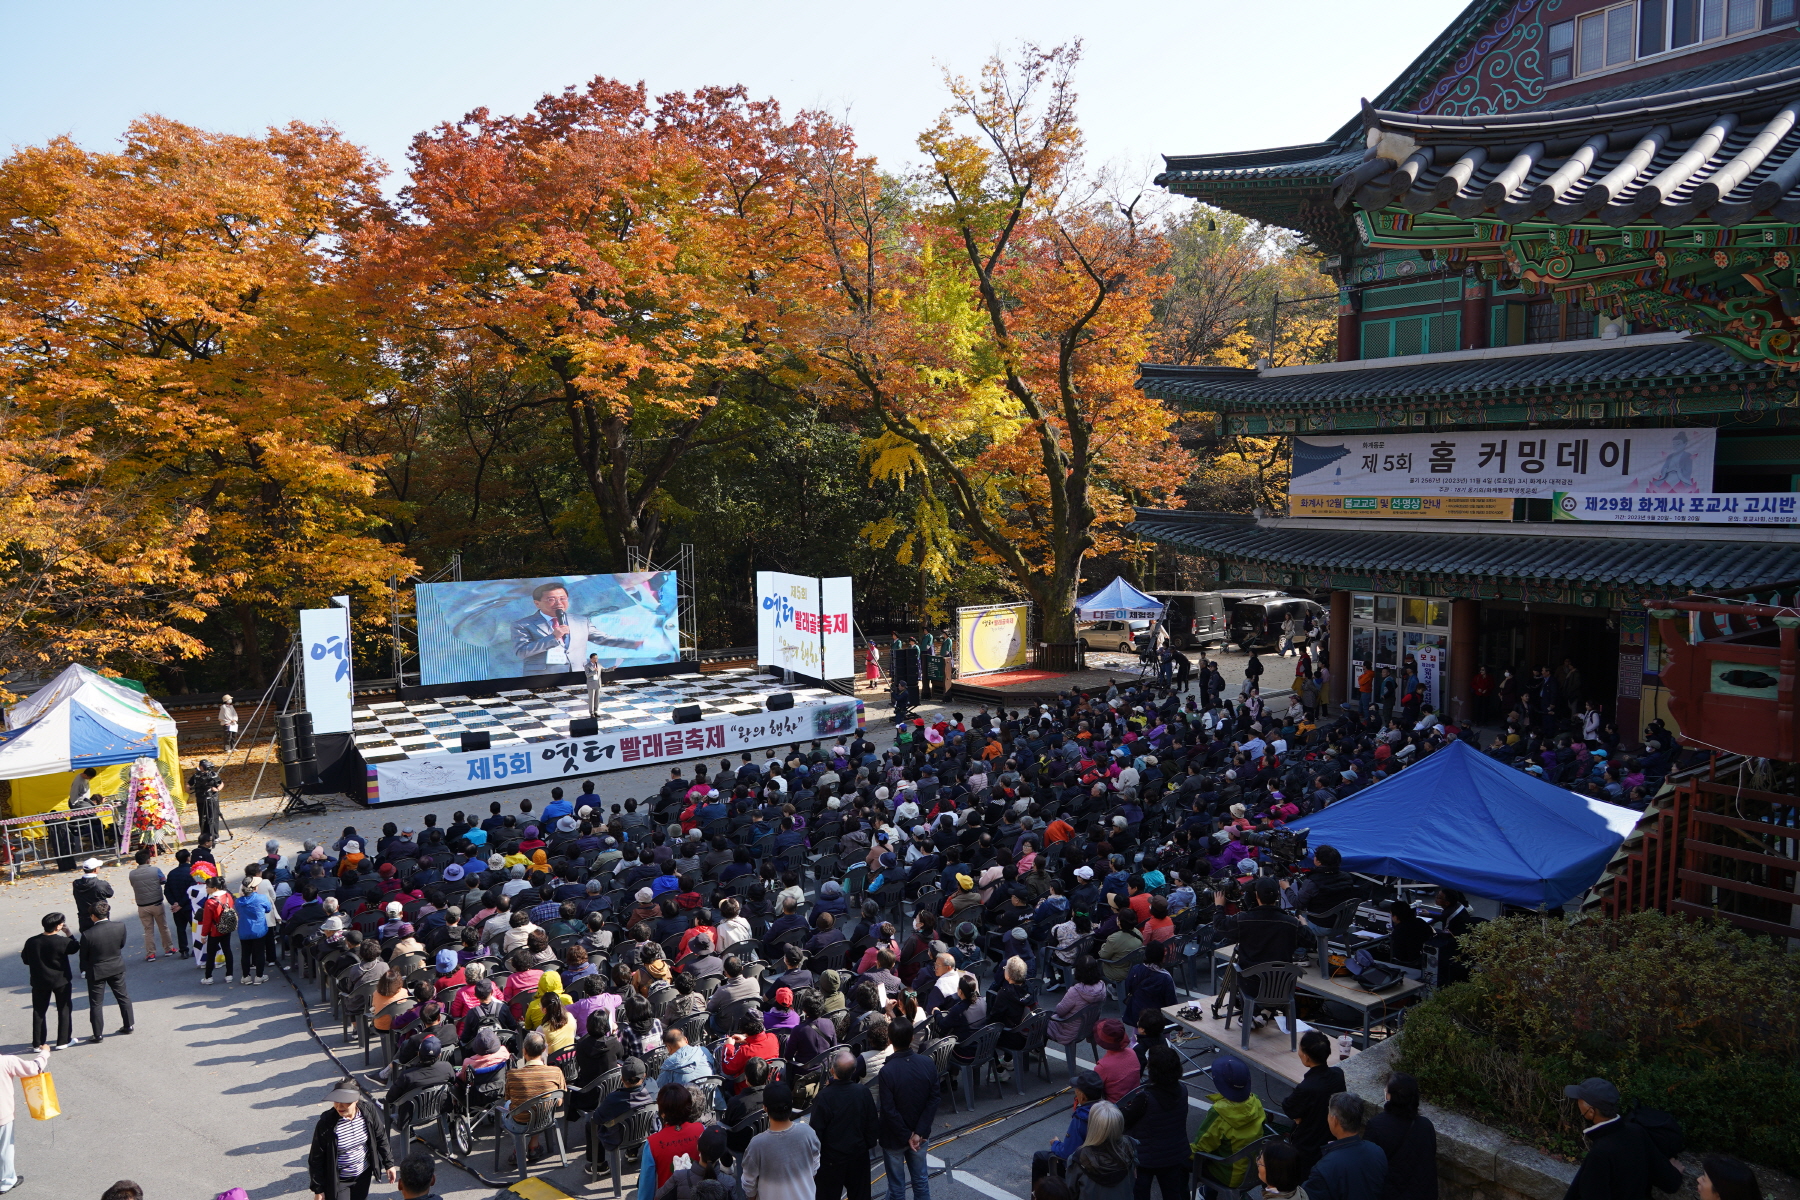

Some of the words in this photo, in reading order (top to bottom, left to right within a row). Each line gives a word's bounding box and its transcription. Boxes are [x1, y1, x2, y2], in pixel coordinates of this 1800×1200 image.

[1482, 477, 1492, 485] 4일
[1493, 477, 1516, 485] (토요일)
[1300, 498, 1324, 509] 화계사
[1326, 498, 1342, 509] 12월
[1344, 498, 1378, 509] 불교교리
[1380, 498, 1389, 509] 및
[1422, 498, 1441, 509] 안내
[1584, 496, 1633, 512] 제29회
[1638, 496, 1686, 513] 화계사
[1689, 497, 1739, 513] 포교사
[1744, 496, 1797, 514] 고시반
[790, 585, 808, 600] 제5회
[762, 592, 794, 629] 옛터
[794, 610, 849, 635] 빨래골축제
[1129, 611, 1155, 619] 체험장
[466, 751, 532, 781] 제5회
[541, 740, 616, 774] 옛터
[619, 724, 726, 763] 빨래골축제
